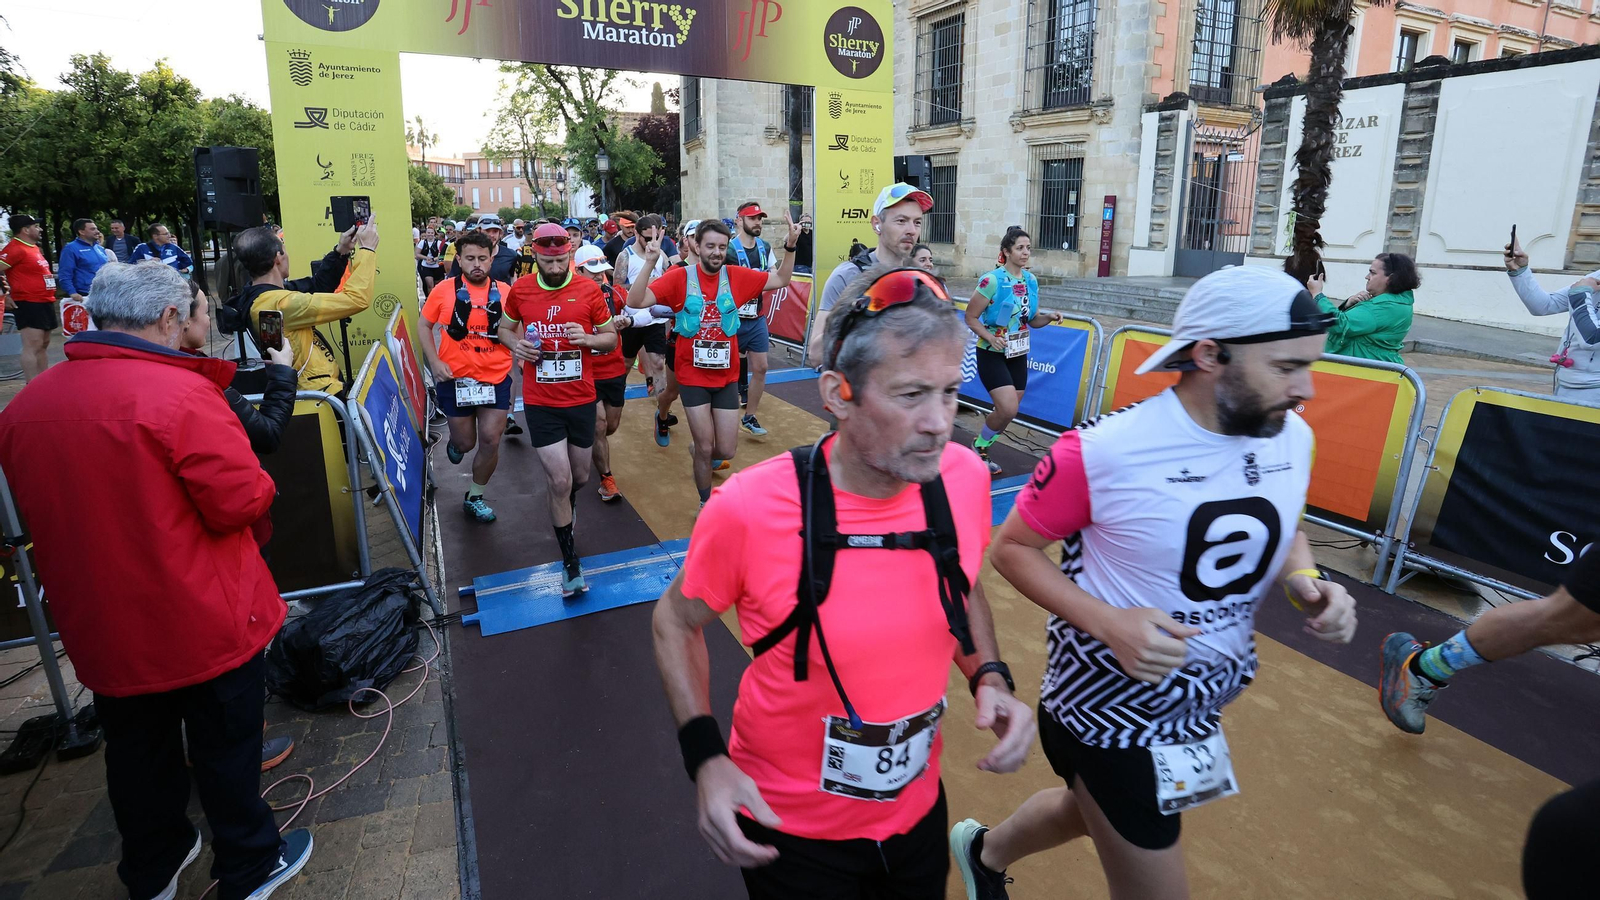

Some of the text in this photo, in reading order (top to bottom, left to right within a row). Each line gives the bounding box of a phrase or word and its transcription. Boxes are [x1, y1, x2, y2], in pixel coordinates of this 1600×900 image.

[582, 22, 676, 48] Maratón
[829, 33, 880, 58] Sherry
[838, 47, 872, 59] Maratón
[318, 62, 381, 73] Ayuntamiento
[318, 71, 355, 80] de Jerez
[845, 101, 882, 110] Ayuntamiento
[853, 107, 866, 115] Jerez
[332, 108, 385, 119] Diputación
[333, 121, 376, 131] de Cádiz
[1333, 115, 1379, 130] AZAR
[850, 135, 882, 144] Diputación
[860, 145, 877, 153] Cádiz
[841, 208, 869, 219] HSN
[707, 348, 718, 358] 66
[552, 360, 566, 372] 15
[467, 386, 483, 397] 184
[876, 740, 910, 775] 84
